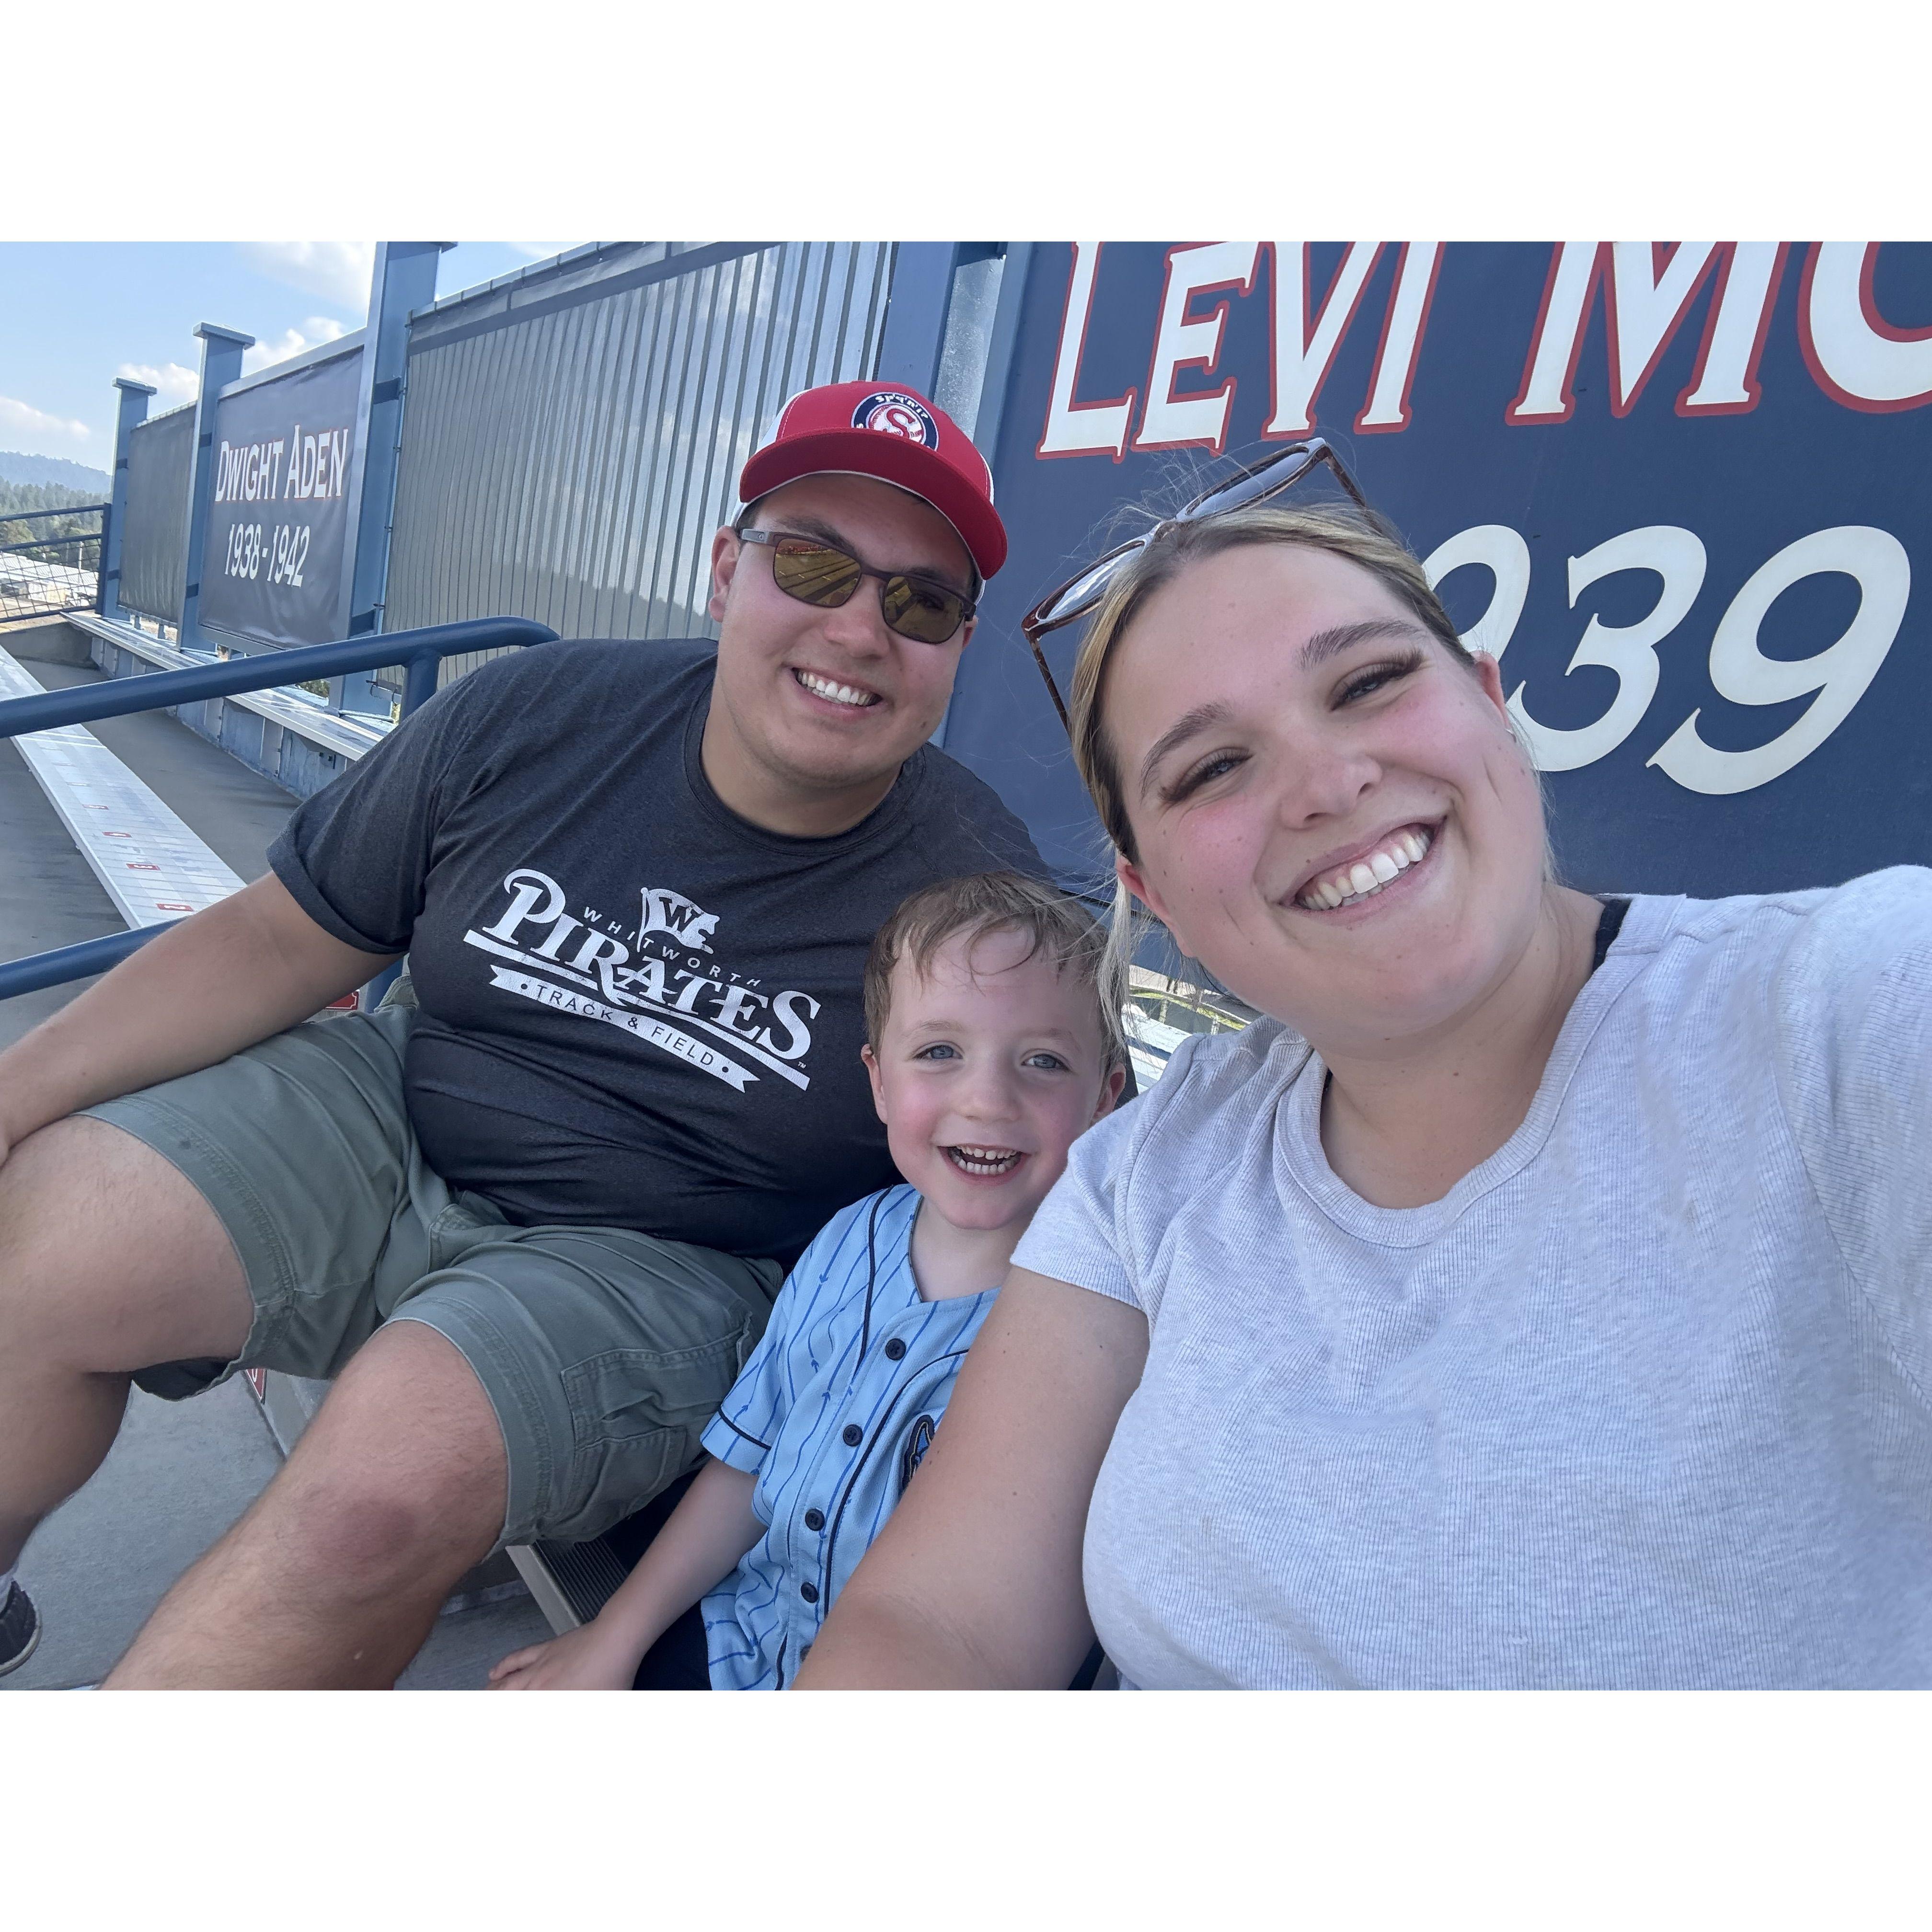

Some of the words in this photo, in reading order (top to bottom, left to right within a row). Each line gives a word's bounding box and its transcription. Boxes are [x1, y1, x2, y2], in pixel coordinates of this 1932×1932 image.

[1035, 242, 1445, 464] LEVI
[215, 437, 284, 502] DWIGHT
[284, 425, 348, 499] ADEN
[225, 523, 310, 587] 1938-1942
[1421, 524, 1910, 794] 39
[583, 906, 761, 987] WHITWORTH
[658, 897, 702, 934] W
[482, 868, 822, 1060] PIRATES
[537, 985, 614, 1021] TRACK
[628, 1016, 638, 1030] &
[651, 1025, 714, 1066] FIELD
